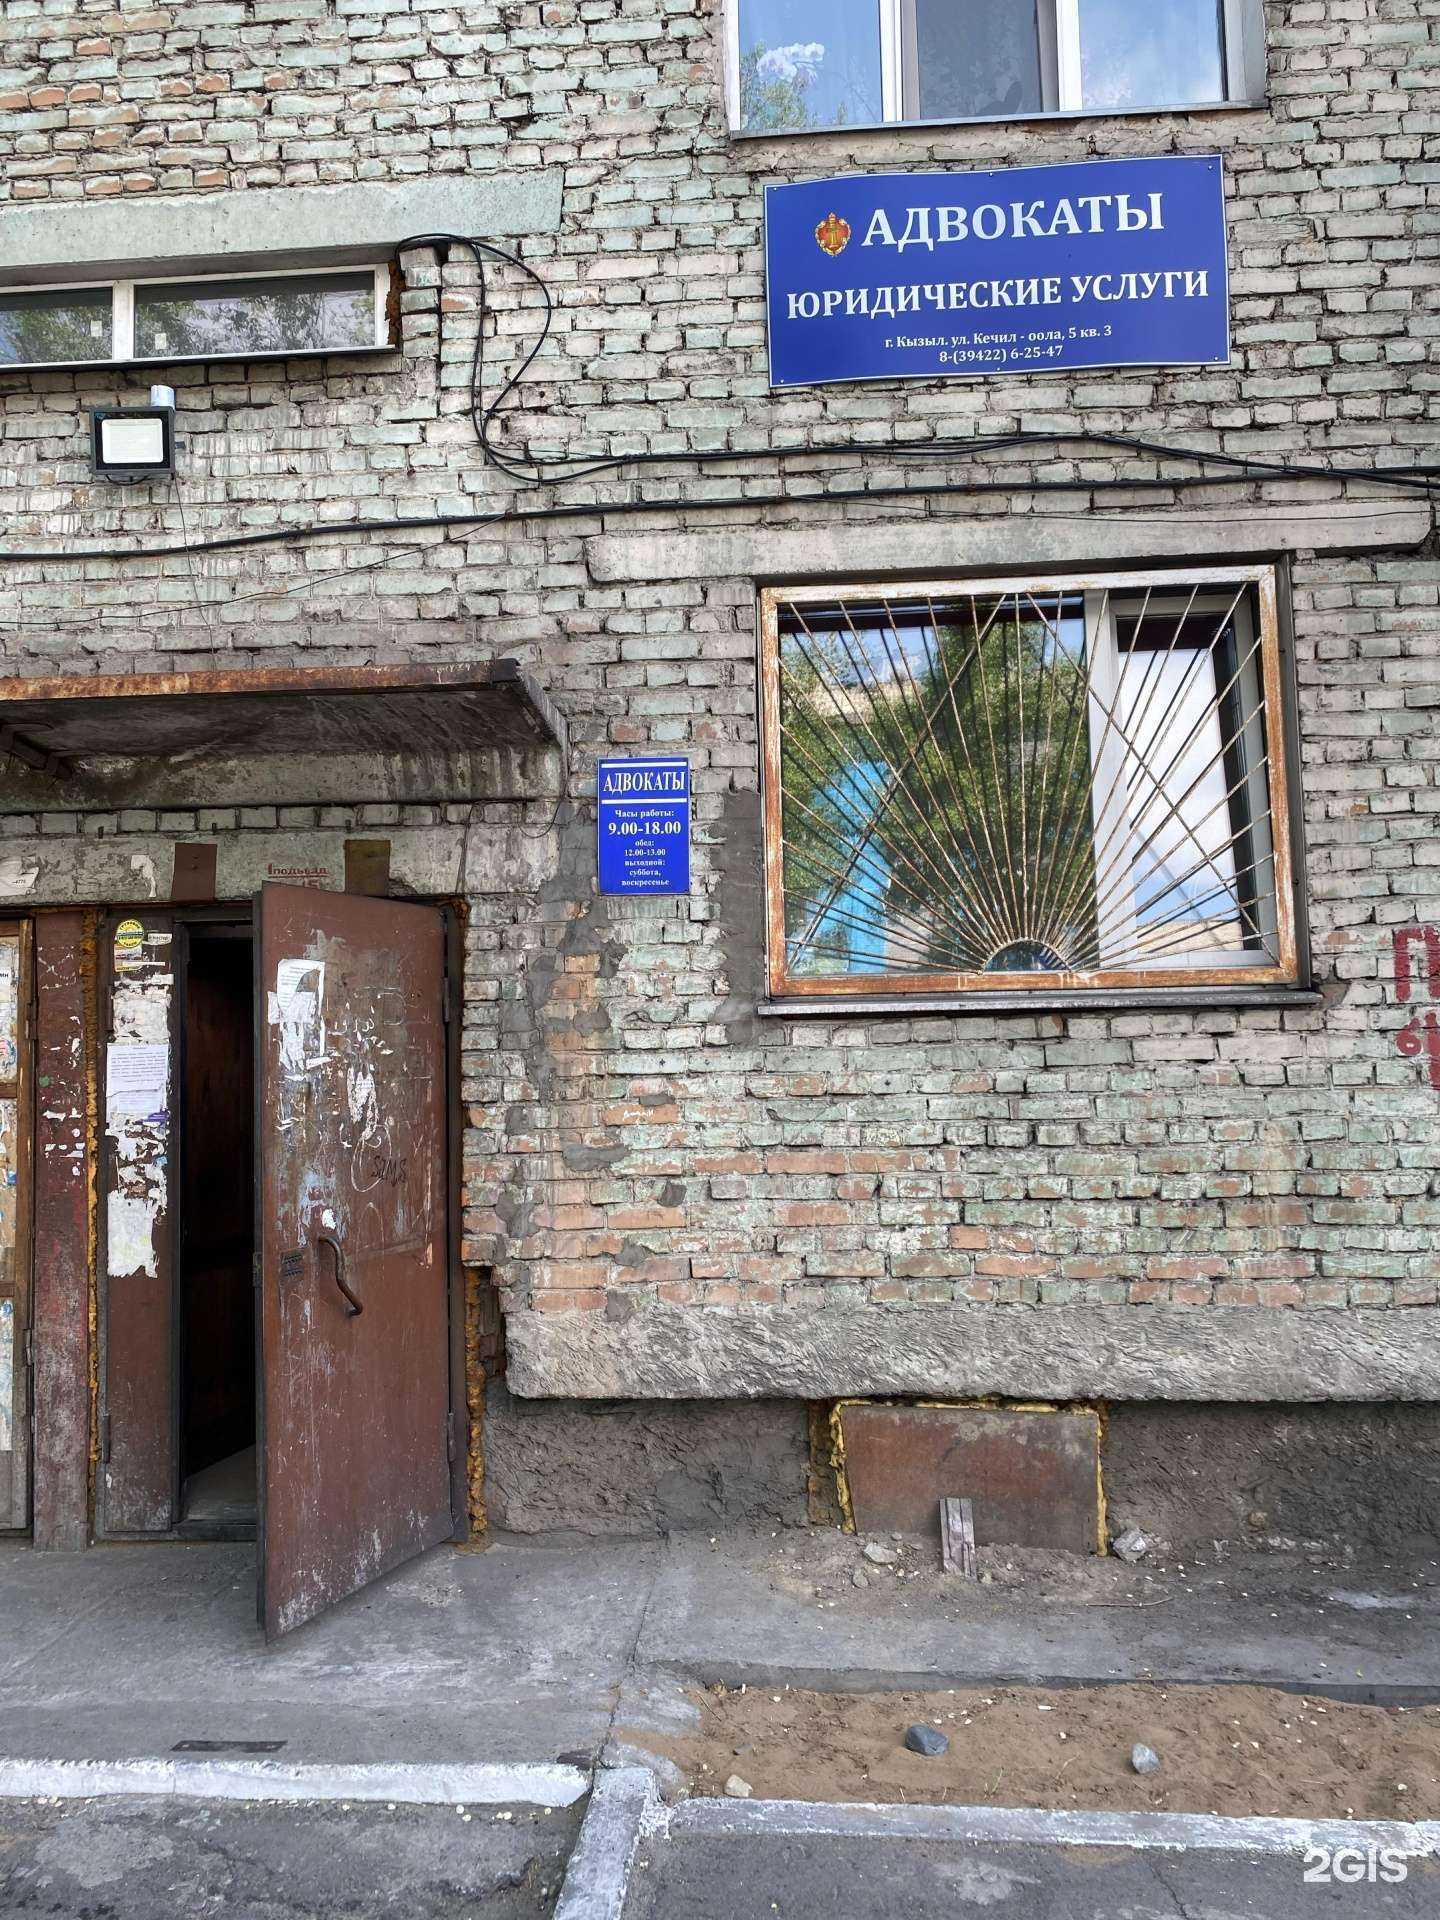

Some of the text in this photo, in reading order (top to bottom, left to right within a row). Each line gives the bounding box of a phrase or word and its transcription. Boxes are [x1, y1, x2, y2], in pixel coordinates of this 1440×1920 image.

[861, 192, 1164, 253] АДВОКАТЫ
[786, 270, 1208, 319] ЮРИДИЧЕСКИЕ УСЛУГИ
[885, 338, 893, 348] г.
[896, 335, 949, 348] Кызыл.
[951, 336, 970, 349] ул.
[973, 332, 1017, 345] Кечил
[1028, 330, 1066, 342] оола,
[1068, 326, 1077, 339] 5
[1080, 327, 1101, 338] кв.
[1103, 325, 1113, 336] 3
[939, 345, 1063, 364] 8-(39422) 6-25-47
[603, 771, 686, 795] АДВОКАТЫ
[615, 809, 675, 819] Часы работы:
[608, 821, 682, 835] 9.00-18.00
